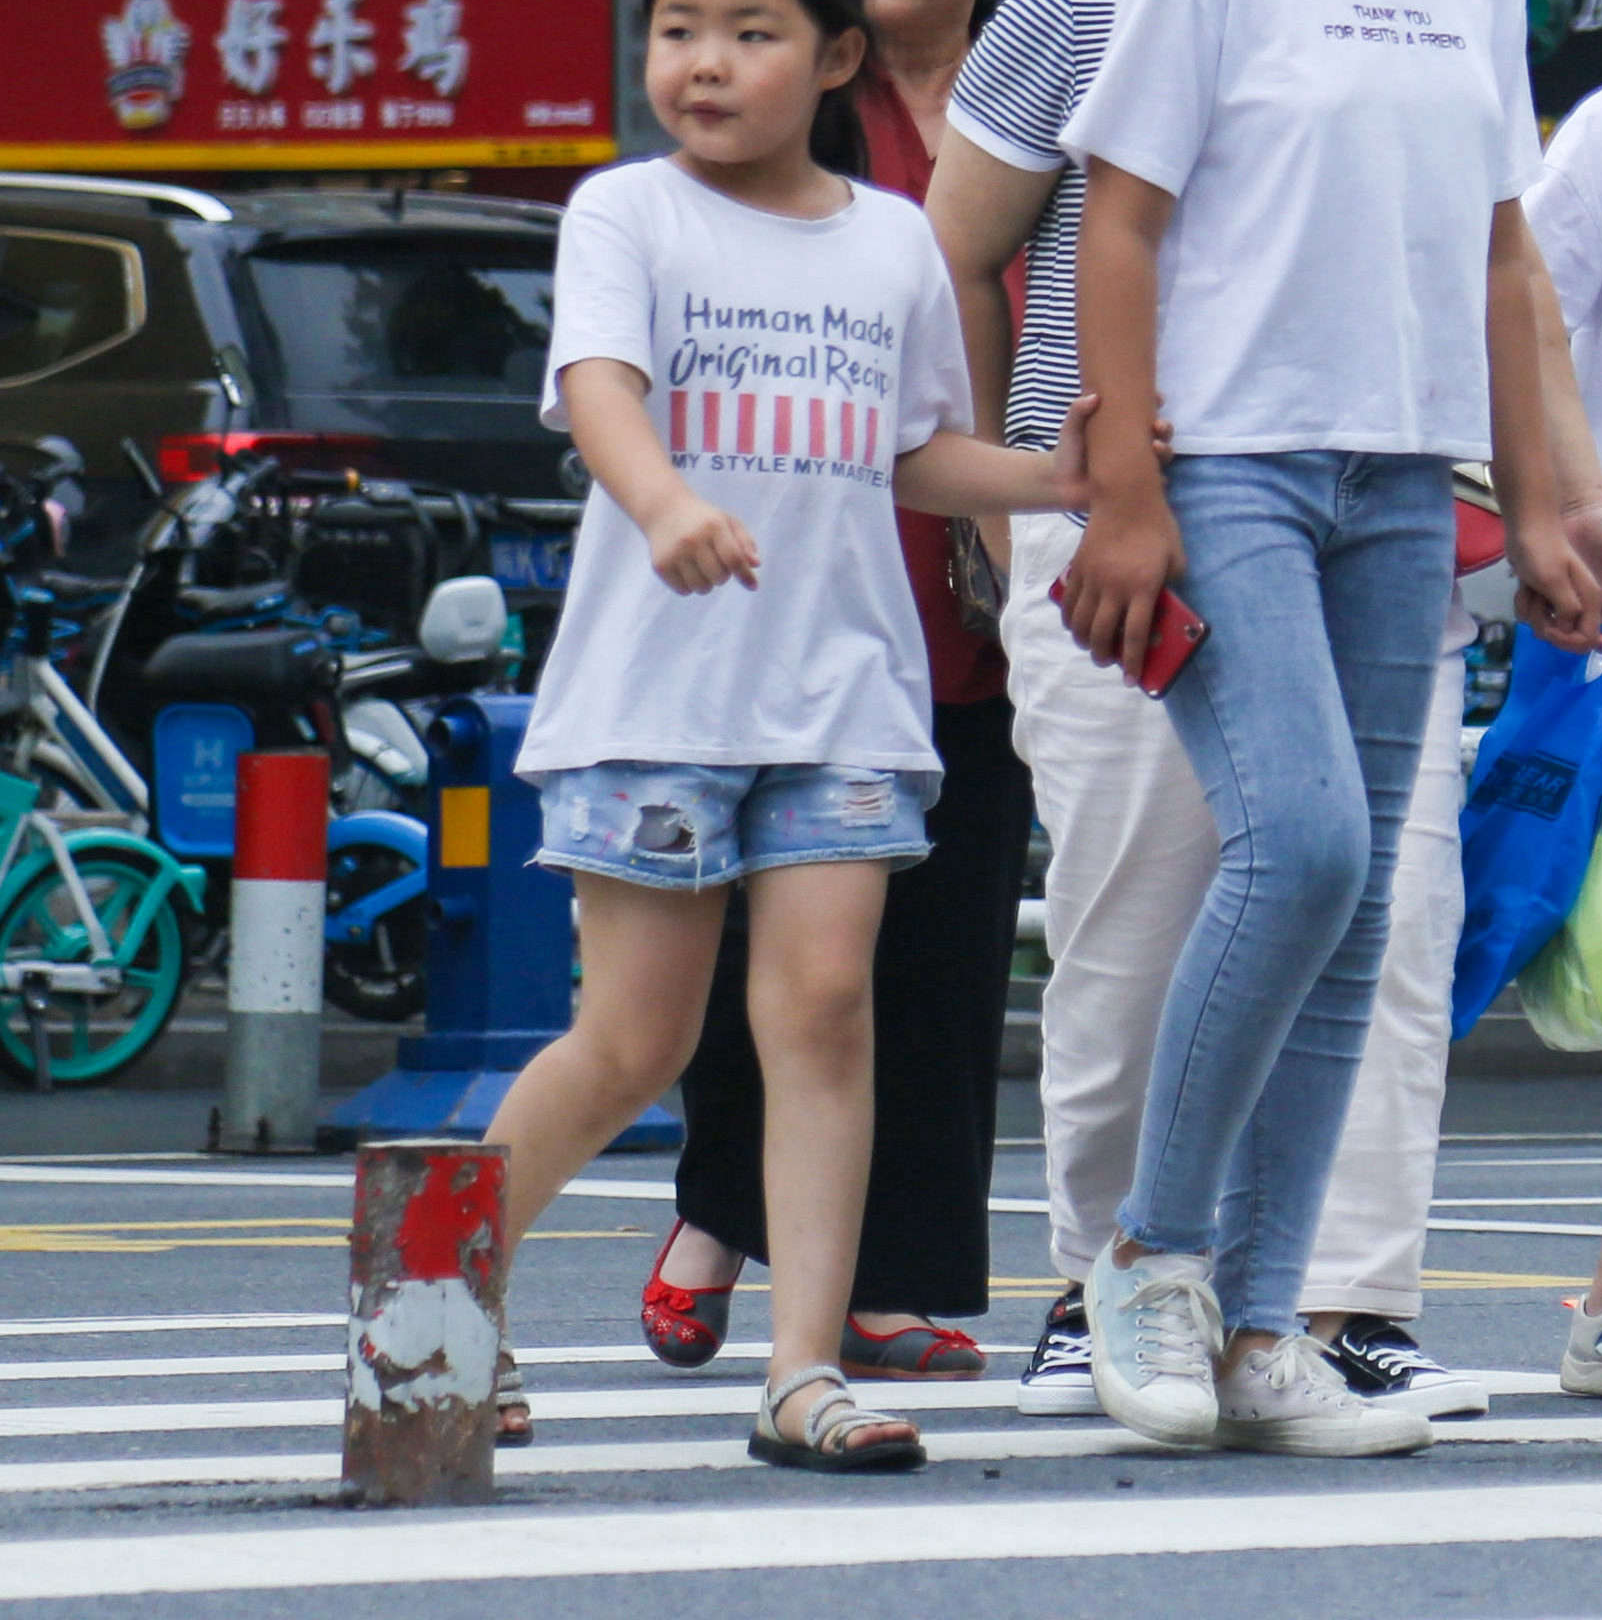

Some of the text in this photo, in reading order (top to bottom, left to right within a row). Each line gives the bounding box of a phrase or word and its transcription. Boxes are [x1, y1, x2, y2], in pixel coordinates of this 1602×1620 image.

[1352, 4, 1433, 27] THANK YOU
[1323, 25, 1355, 41] FOR
[1405, 32, 1415, 45] A
[683, 292, 894, 350] Human Made
[671, 453, 702, 470] MY
[711, 455, 787, 473] STYLE
[794, 458, 826, 475] MY
